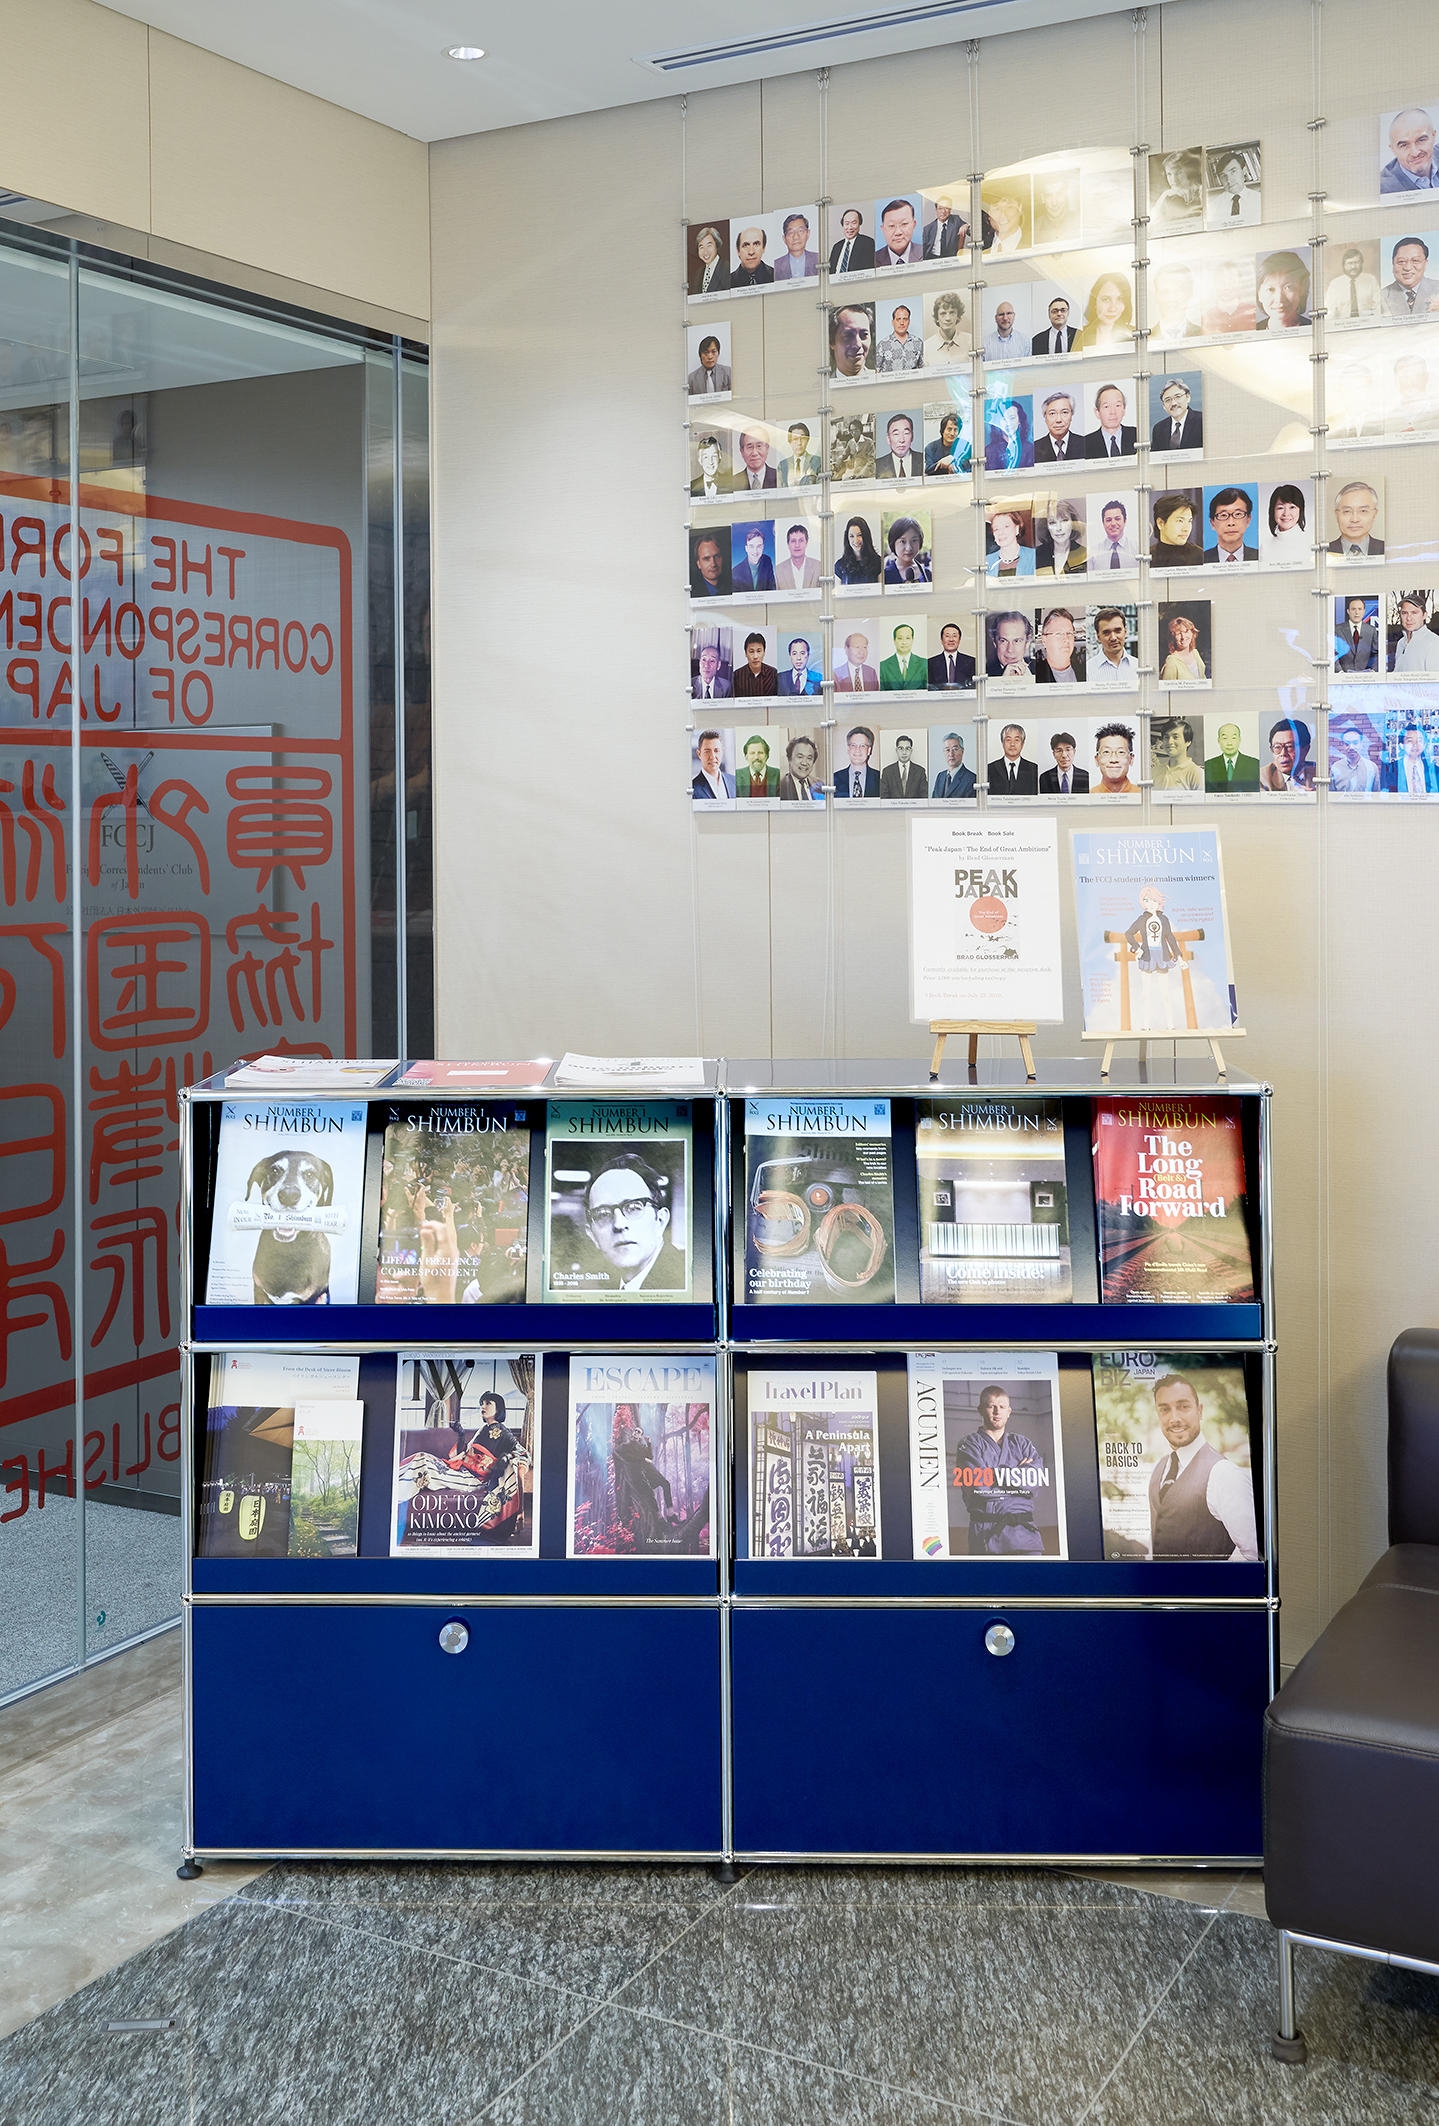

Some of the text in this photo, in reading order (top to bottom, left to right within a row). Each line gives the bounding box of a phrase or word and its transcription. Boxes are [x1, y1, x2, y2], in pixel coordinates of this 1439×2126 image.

[1118, 840, 1170, 849] NUMBER 1
[1096, 848, 1194, 865] SHIMBUN
[120, 879, 145, 890] Jan
[954, 869, 1017, 886] PEAK
[1080, 876, 1094, 884] The
[1185, 874, 1216, 882] winners
[955, 884, 1018, 898] JAPAN
[268, 1106, 321, 1117] NUMBER 1
[430, 1107, 484, 1118] NUMBER 1
[592, 1107, 646, 1118] NUMBER 1
[790, 1105, 844, 1116] NUMBER 1
[962, 1104, 1015, 1115] NUMBER 1
[1139, 1102, 1192, 1112] NUMBER 1
[244, 1114, 344, 1133] SHIMBUN
[406, 1114, 508, 1134] SHIMBUN
[568, 1117, 669, 1134] SHIMBUN
[767, 1114, 867, 1132] SHIMBUN
[939, 1113, 1039, 1132] SHIMBUN
[1118, 1110, 1216, 1129] SHIMBUN
[1144, 1134, 1192, 1156] The
[1137, 1152, 1203, 1178] Long
[1153, 1174, 1174, 1184] (Belt
[1139, 1178, 1202, 1200] Road
[1120, 1195, 1226, 1218] Forward
[382, 1256, 402, 1265] LIFE
[416, 1256, 424, 1265] A
[426, 1256, 480, 1265] FREELANCE
[380, 1268, 478, 1277] CORRESPONDENT
[553, 1272, 610, 1280] Charles Smith
[749, 1268, 808, 1279] Celebrating
[946, 1264, 992, 1279] Come
[749, 1279, 812, 1289] our birthday
[1100, 1352, 1154, 1367] EURO
[585, 1367, 702, 1392] ESCAPE
[1100, 1369, 1131, 1386] BIZ
[805, 1430, 870, 1440] A Peninsula
[916, 1380, 940, 1488] ACUMEN
[838, 1442, 870, 1454] Apart
[1105, 1442, 1143, 1455] BACK TO
[1106, 1455, 1139, 1468] BASICS
[952, 1467, 1050, 1487] 2020 VISION
[412, 1494, 478, 1511] ODE TO
[410, 1512, 479, 1529] KIMONO
